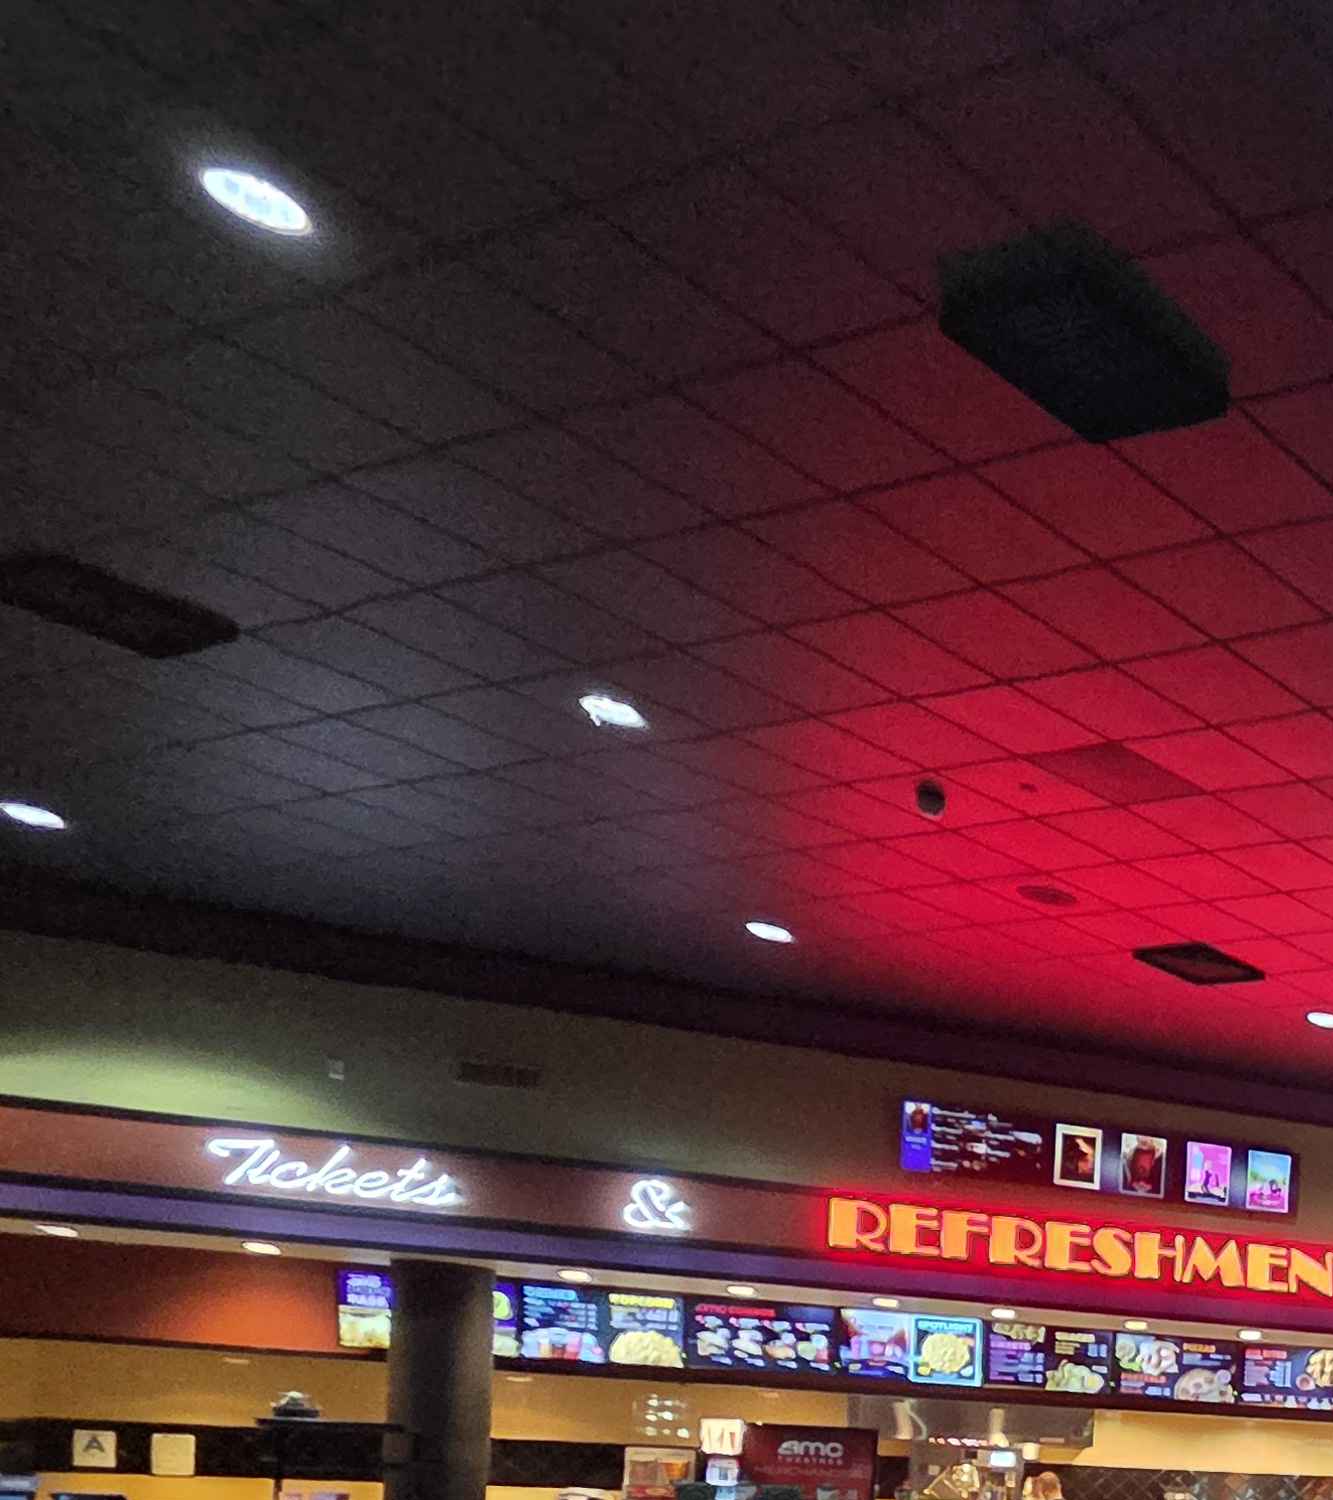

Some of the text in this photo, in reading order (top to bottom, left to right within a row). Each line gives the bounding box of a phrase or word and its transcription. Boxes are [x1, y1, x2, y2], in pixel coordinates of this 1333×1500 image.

[207, 1136, 692, 1231] Tickets &
[83, 1436, 105, 1453] A
